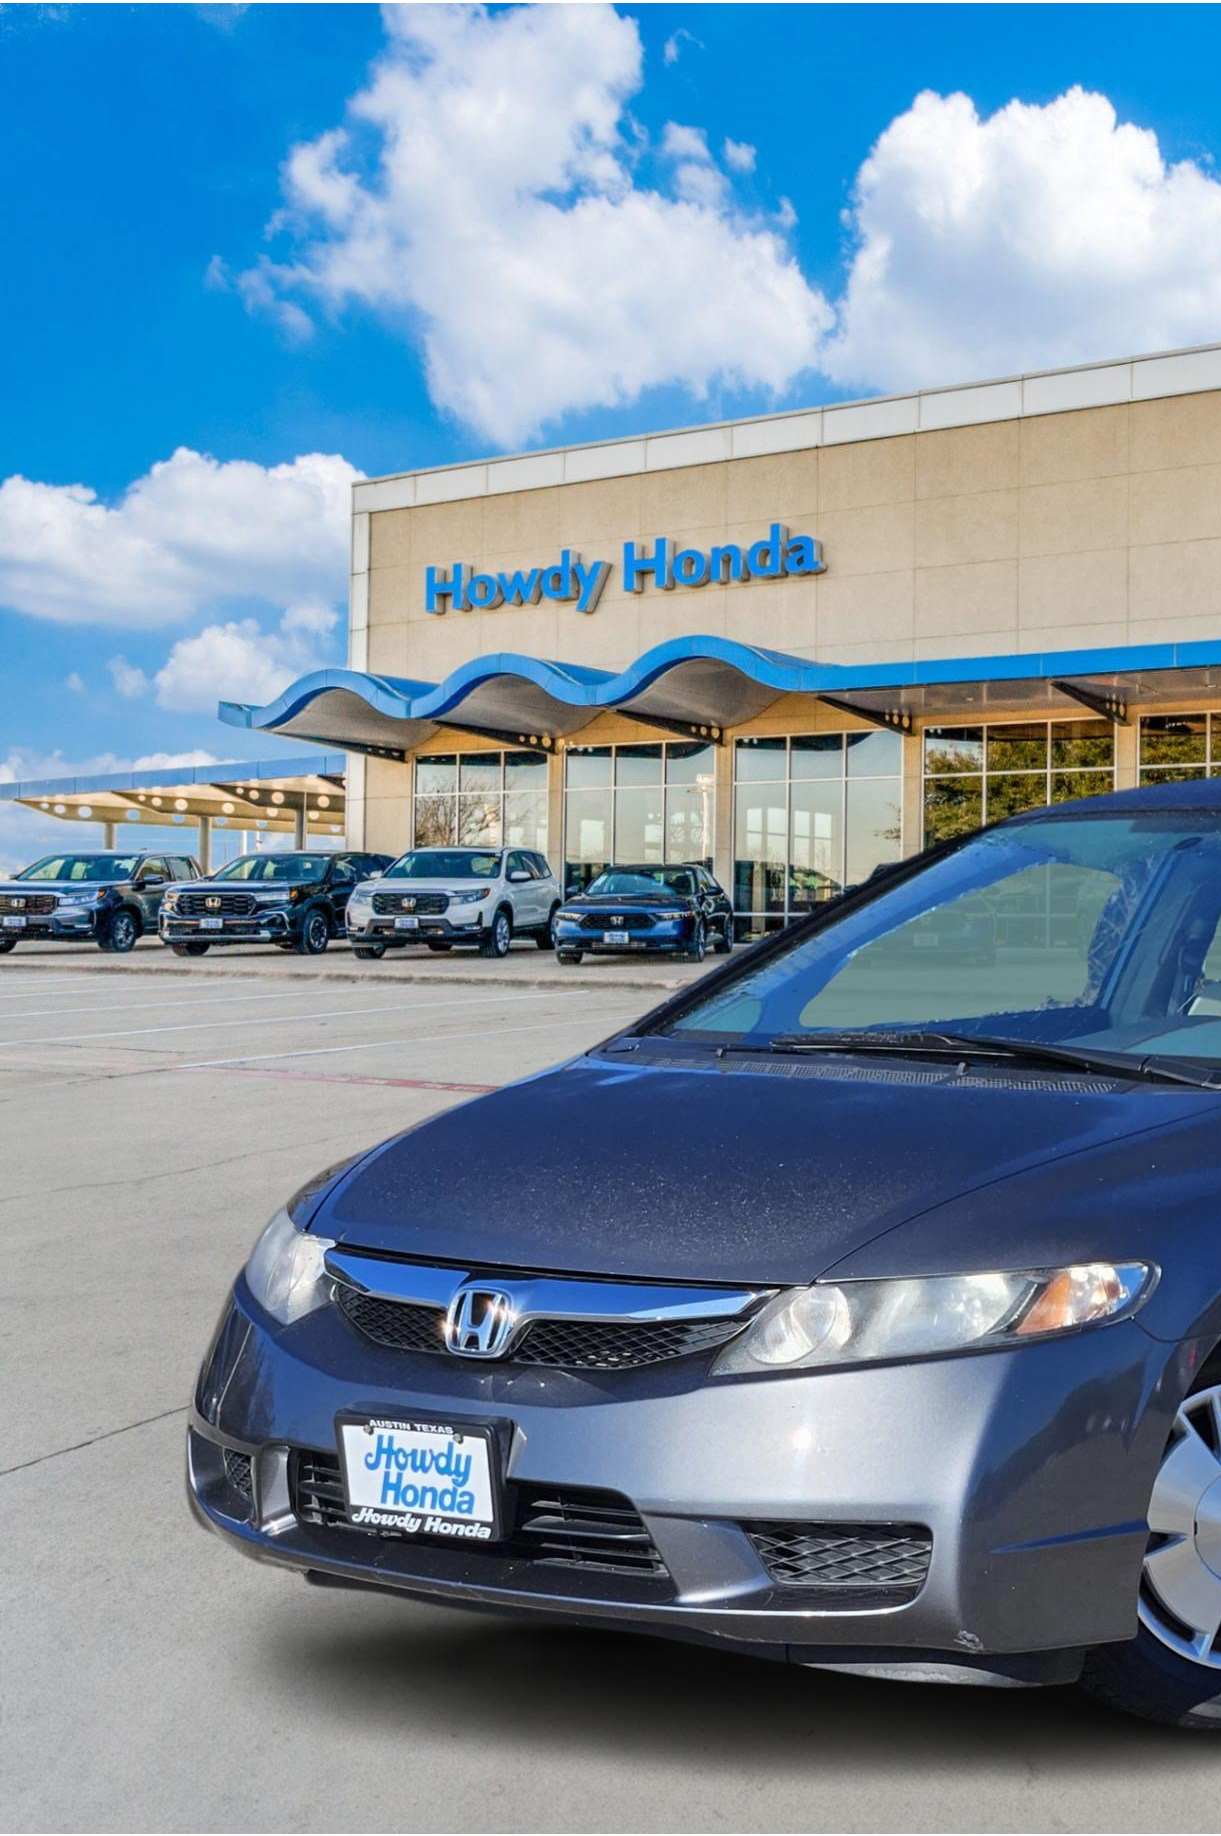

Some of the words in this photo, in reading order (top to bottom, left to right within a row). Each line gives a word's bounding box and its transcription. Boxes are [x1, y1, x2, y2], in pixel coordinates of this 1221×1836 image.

[425, 549, 611, 614] Howdy
[623, 523, 827, 594] Honda
[369, 1419, 411, 1431] AUSTIN
[414, 1423, 454, 1435] TEXAS
[364, 1434, 472, 1488] Howdy
[380, 1471, 475, 1515] Honda
[352, 1507, 422, 1533] Howdy
[424, 1516, 492, 1539] Honda
